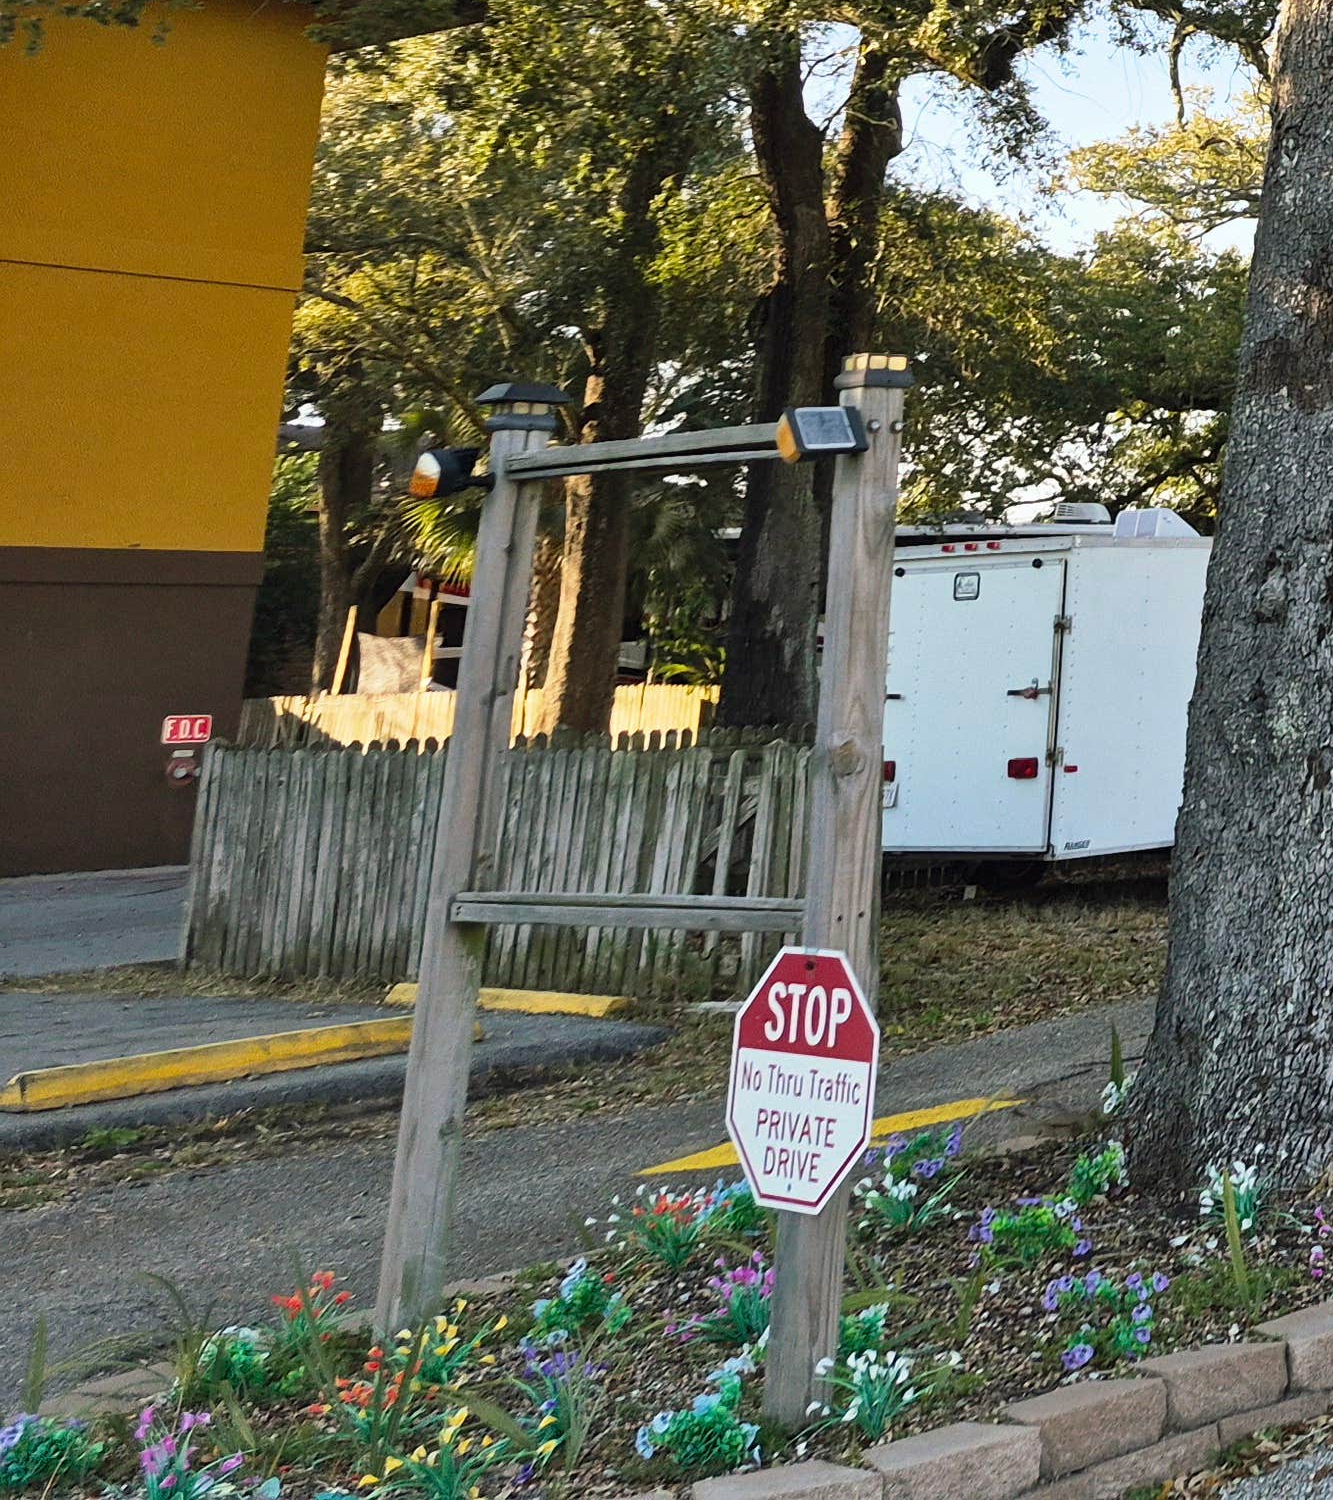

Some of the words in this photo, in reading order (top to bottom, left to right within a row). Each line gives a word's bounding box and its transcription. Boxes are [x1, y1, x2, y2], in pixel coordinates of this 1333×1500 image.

[165, 719, 208, 739] F.D.C.
[764, 981, 853, 1048] STOP
[740, 1061, 762, 1091] No
[767, 1064, 803, 1096] Thru
[808, 1069, 862, 1105] Traffic
[755, 1108, 838, 1148] PRIVATE
[763, 1146, 821, 1184] DRIVE
